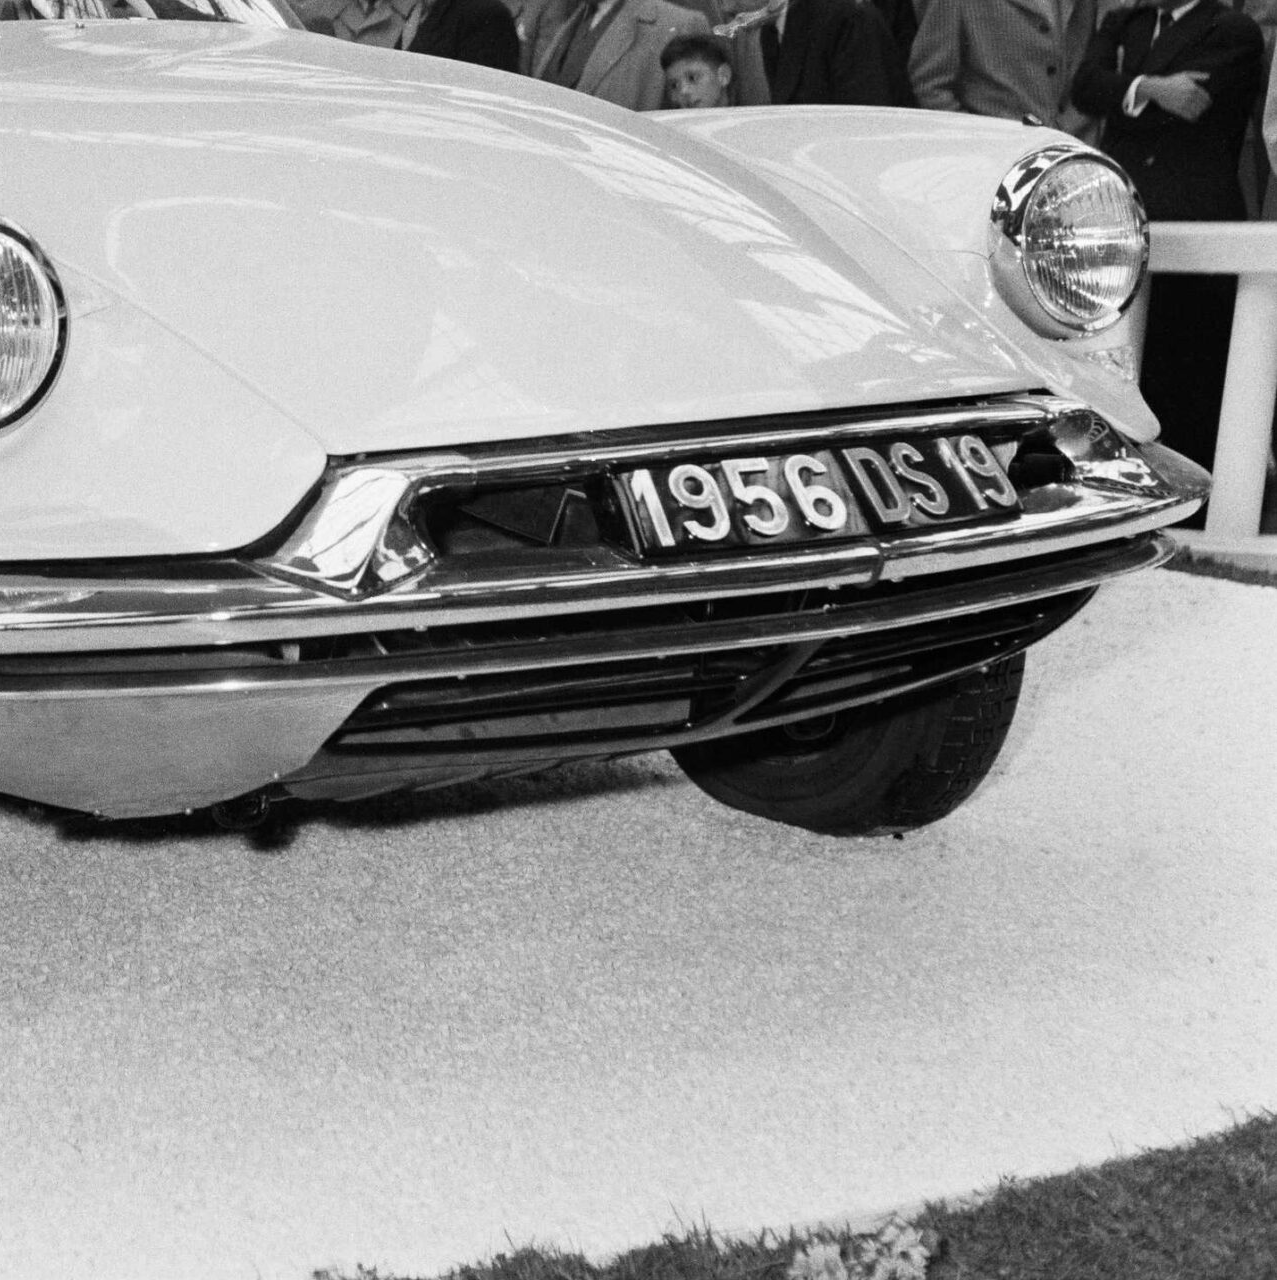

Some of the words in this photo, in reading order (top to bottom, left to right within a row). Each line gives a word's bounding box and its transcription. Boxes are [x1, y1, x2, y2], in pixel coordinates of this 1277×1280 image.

[630, 452, 848, 548] 1956
[841, 442, 950, 524] DS
[937, 434, 1019, 511] 19
